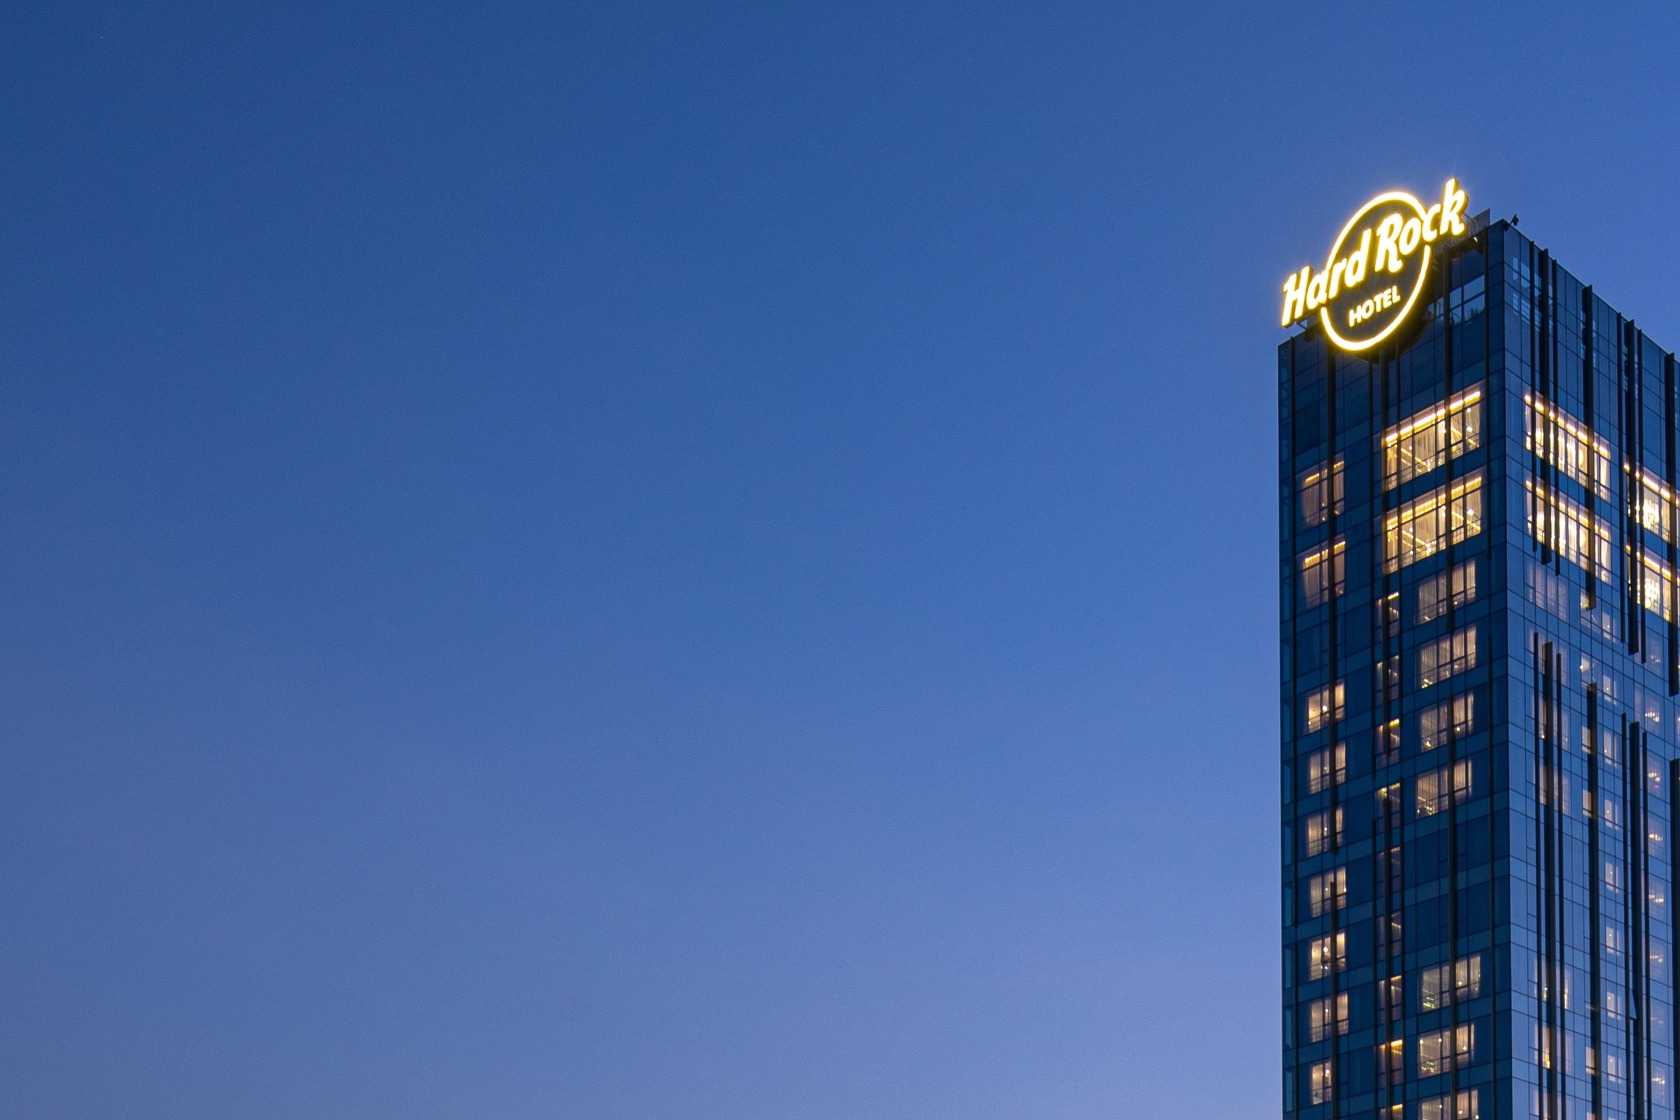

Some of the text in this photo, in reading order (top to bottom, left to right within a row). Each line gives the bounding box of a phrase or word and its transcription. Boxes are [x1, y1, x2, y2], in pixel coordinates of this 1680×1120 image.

[1281, 177, 1470, 328] Hard Rock
[1348, 285, 1401, 327] HOTEL
